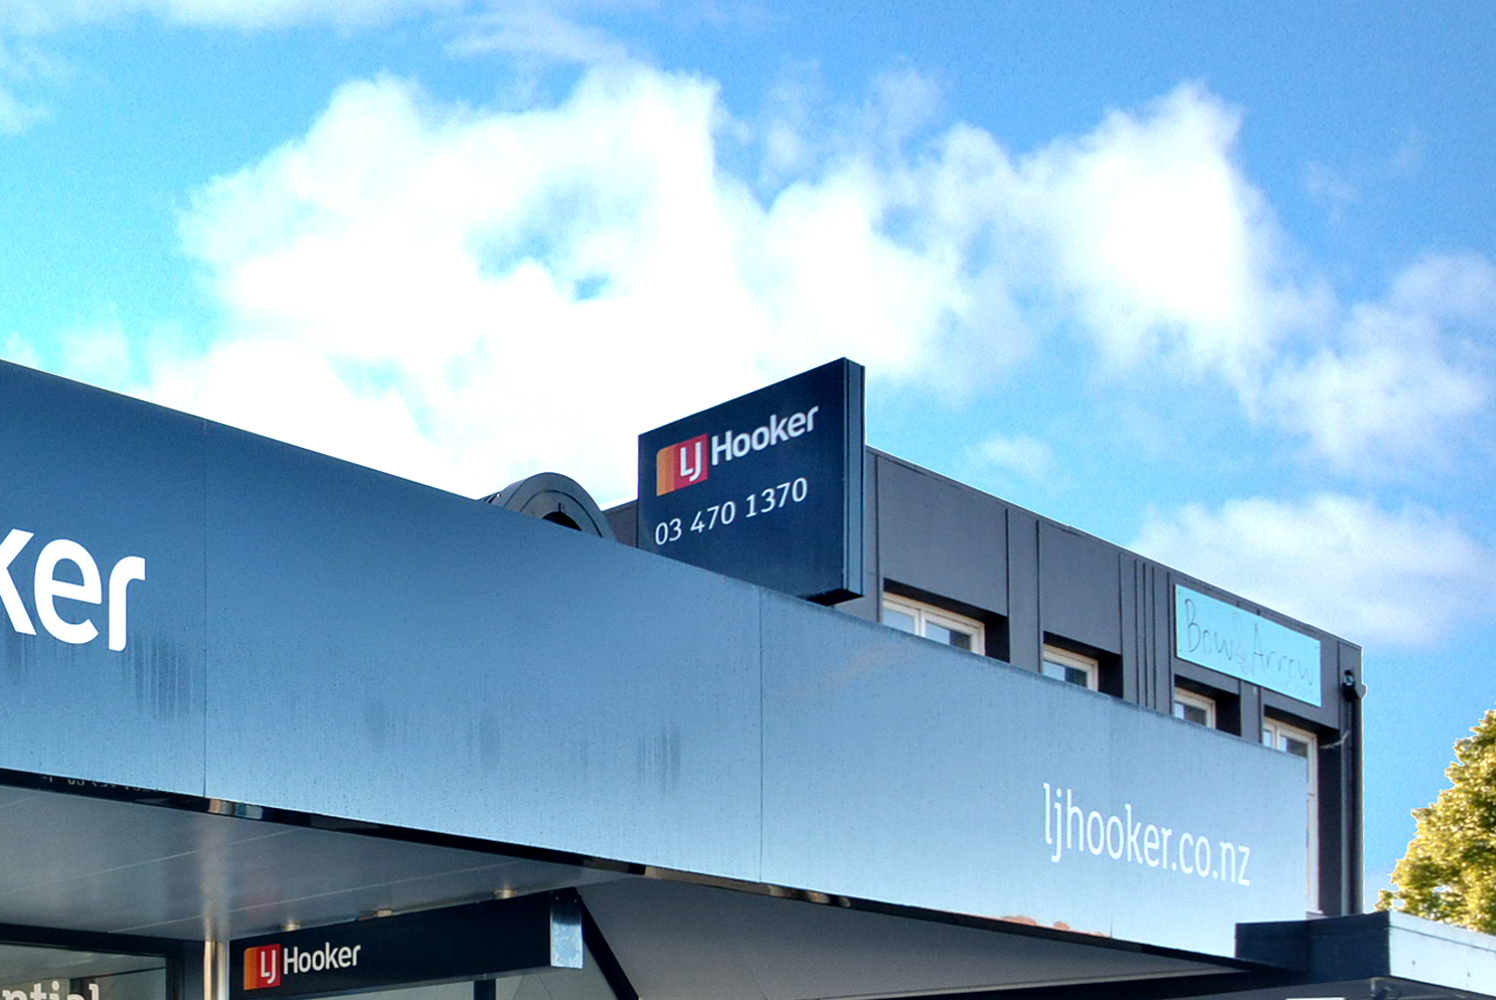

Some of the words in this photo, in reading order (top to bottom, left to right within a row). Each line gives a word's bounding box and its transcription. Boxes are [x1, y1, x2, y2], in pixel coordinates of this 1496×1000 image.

[680, 441, 701, 482] LJ
[711, 405, 819, 466] Hooker
[654, 518, 682, 546] 03
[689, 500, 737, 534] 470
[745, 477, 808, 518] 1370
[1184, 598, 1234, 662] Bow
[1252, 622, 1315, 687] Arrow
[1042, 782, 1251, 887] ljhooker.co.nz
[261, 949, 277, 985] LJ
[284, 941, 362, 975] Hooker
